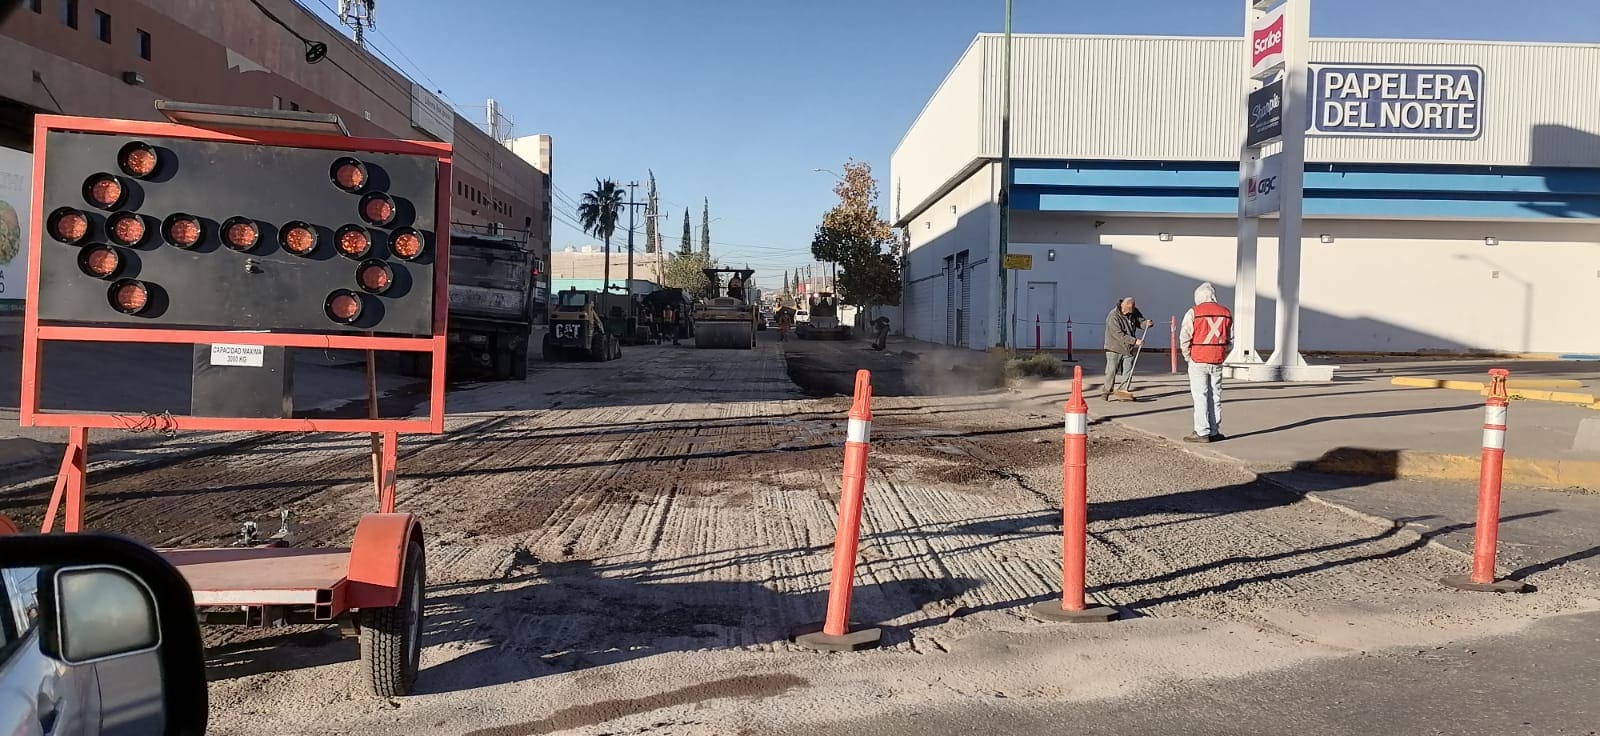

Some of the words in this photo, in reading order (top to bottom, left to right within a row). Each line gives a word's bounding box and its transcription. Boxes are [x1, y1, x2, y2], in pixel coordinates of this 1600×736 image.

[1254, 30, 1281, 55] Scribe
[1325, 72, 1475, 101] PAPELERA
[1250, 93, 1280, 127] Sharpie
[1323, 101, 1376, 128] DEL
[1380, 102, 1475, 129] NORTE
[1258, 175, 1277, 196] GBC
[556, 323, 580, 338] CAT
